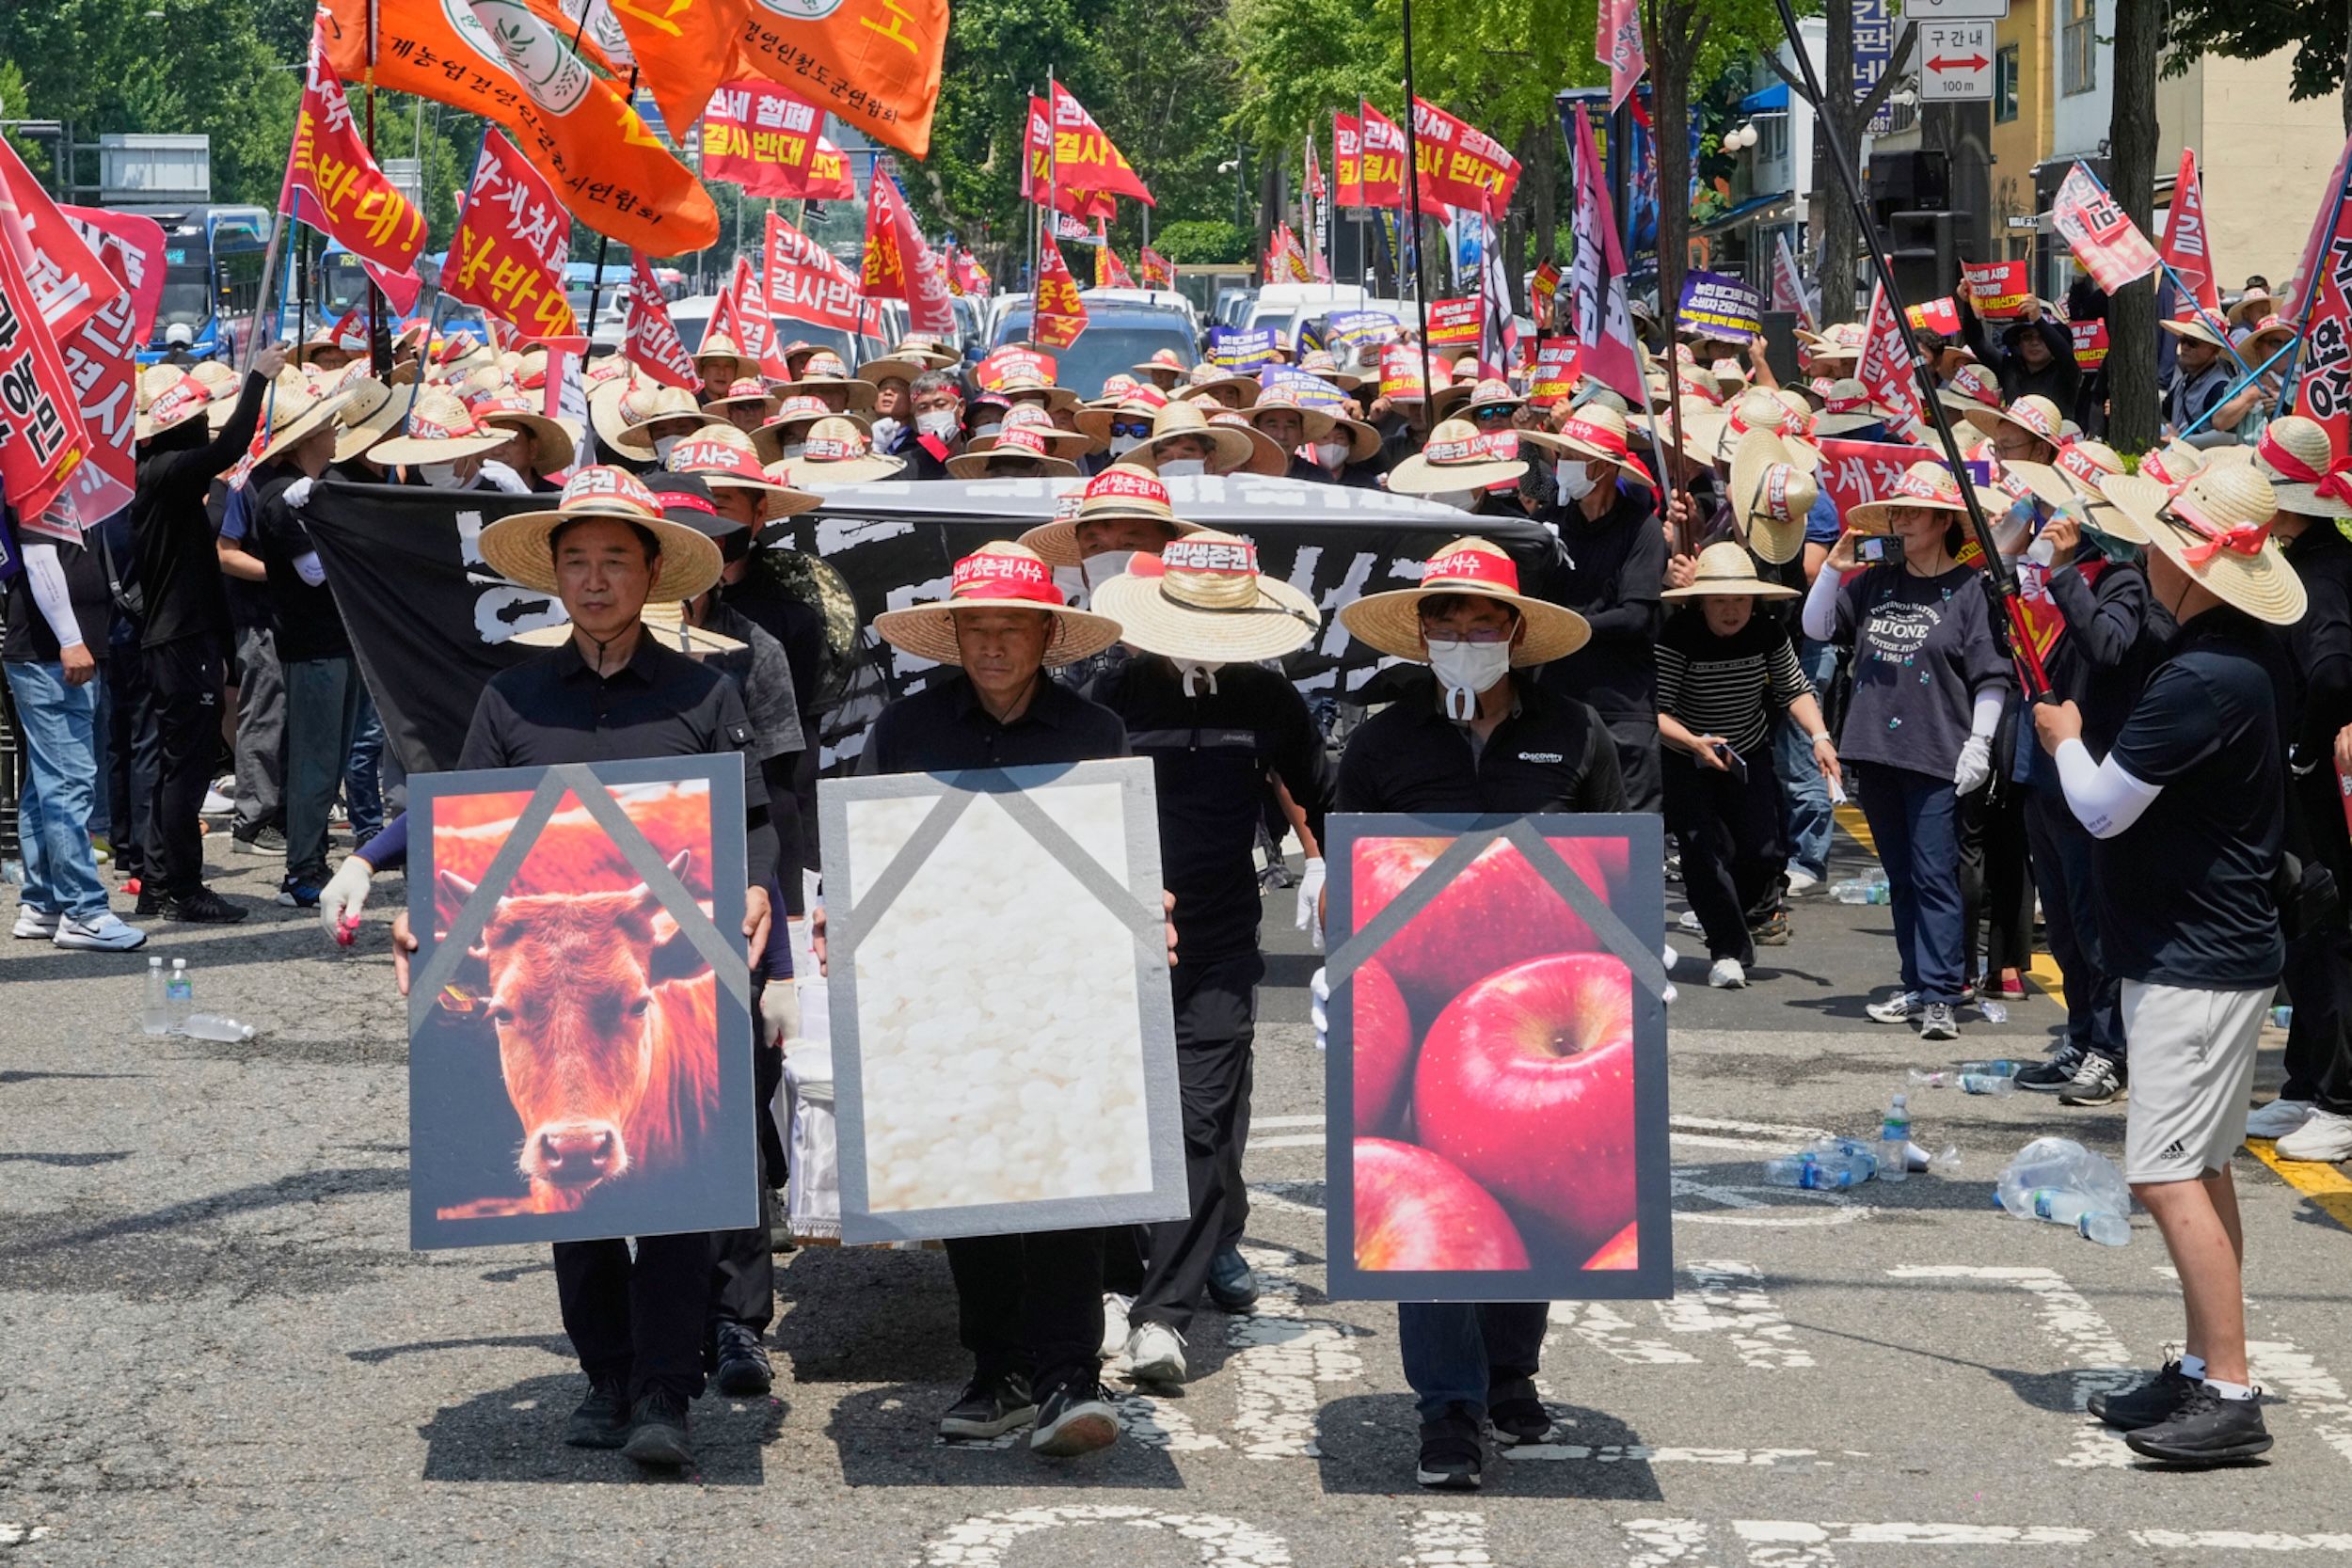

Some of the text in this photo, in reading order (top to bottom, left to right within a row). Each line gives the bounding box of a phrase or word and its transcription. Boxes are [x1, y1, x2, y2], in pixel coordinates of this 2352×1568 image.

[755, 93, 816, 134] 철폐
[703, 122, 806, 167] 결사 반대
[1055, 132, 1109, 166] 결사
[1448, 151, 1505, 196] 반대
[340, 254, 358, 267] 752
[696, 443, 740, 468] 사수
[1867, 619, 1930, 639] BUONE
